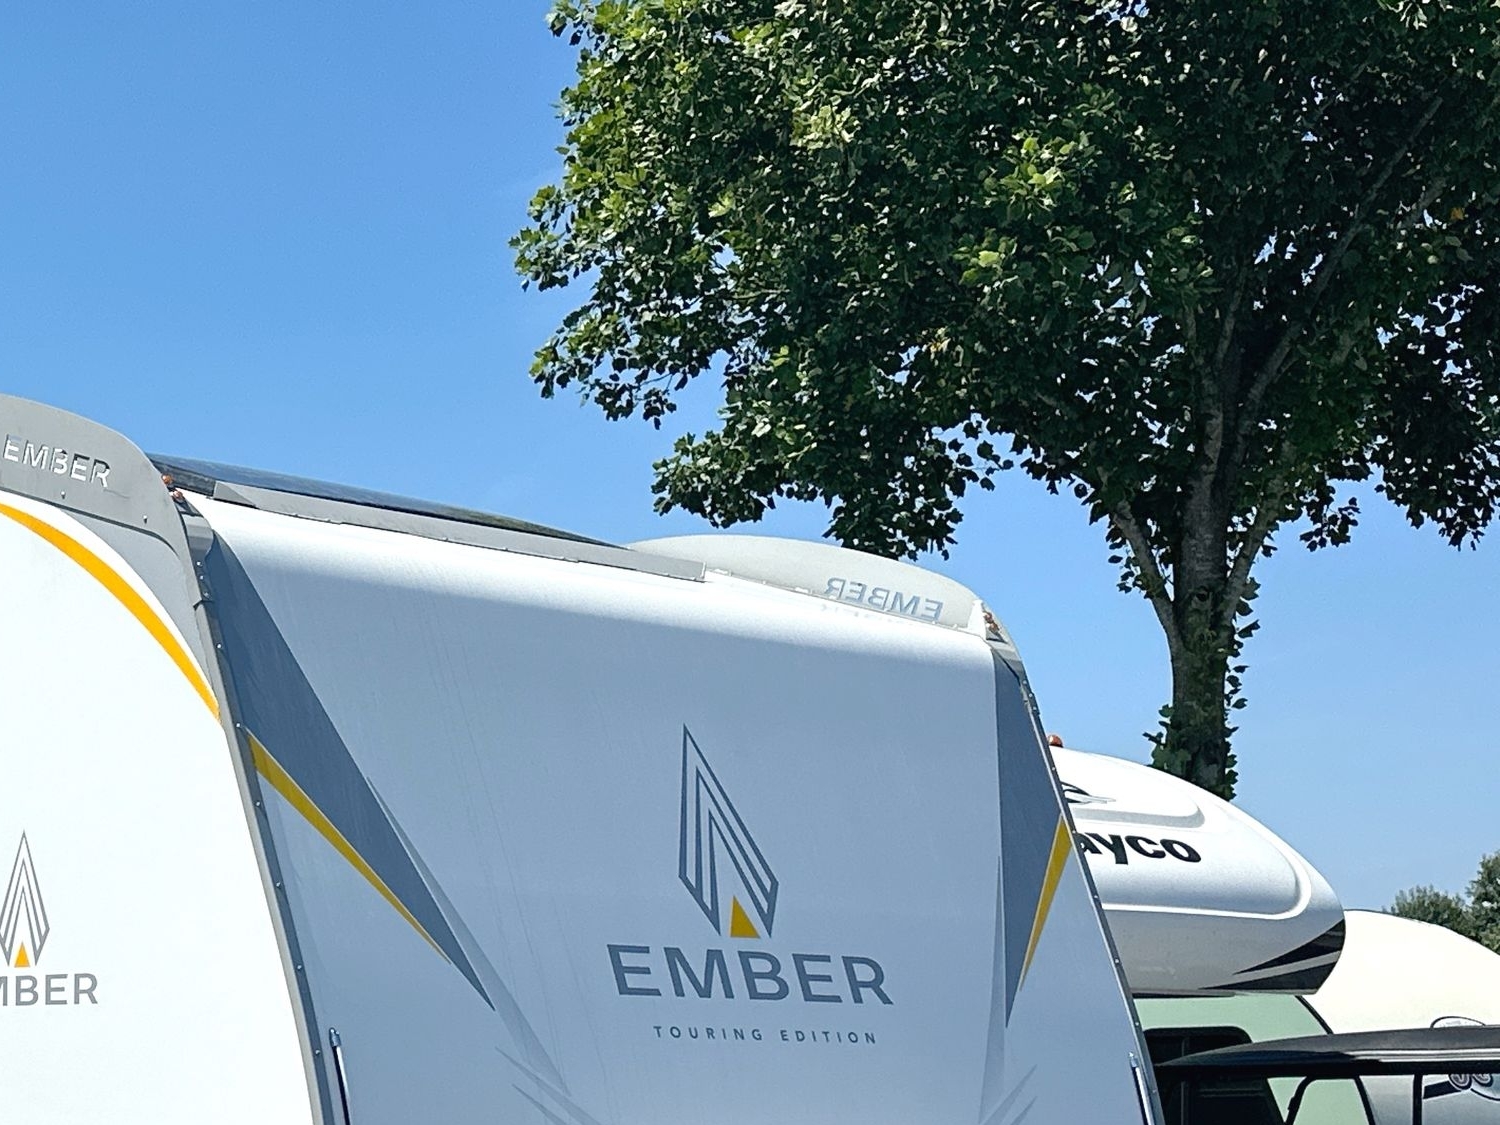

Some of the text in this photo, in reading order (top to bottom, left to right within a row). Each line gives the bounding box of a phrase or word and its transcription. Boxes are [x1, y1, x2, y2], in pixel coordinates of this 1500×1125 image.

[3, 434, 111, 488] EMBER
[1073, 832, 1202, 865] AYCO
[606, 944, 894, 1005] EMBER
[653, 1025, 877, 1045] TOURING EDITION
